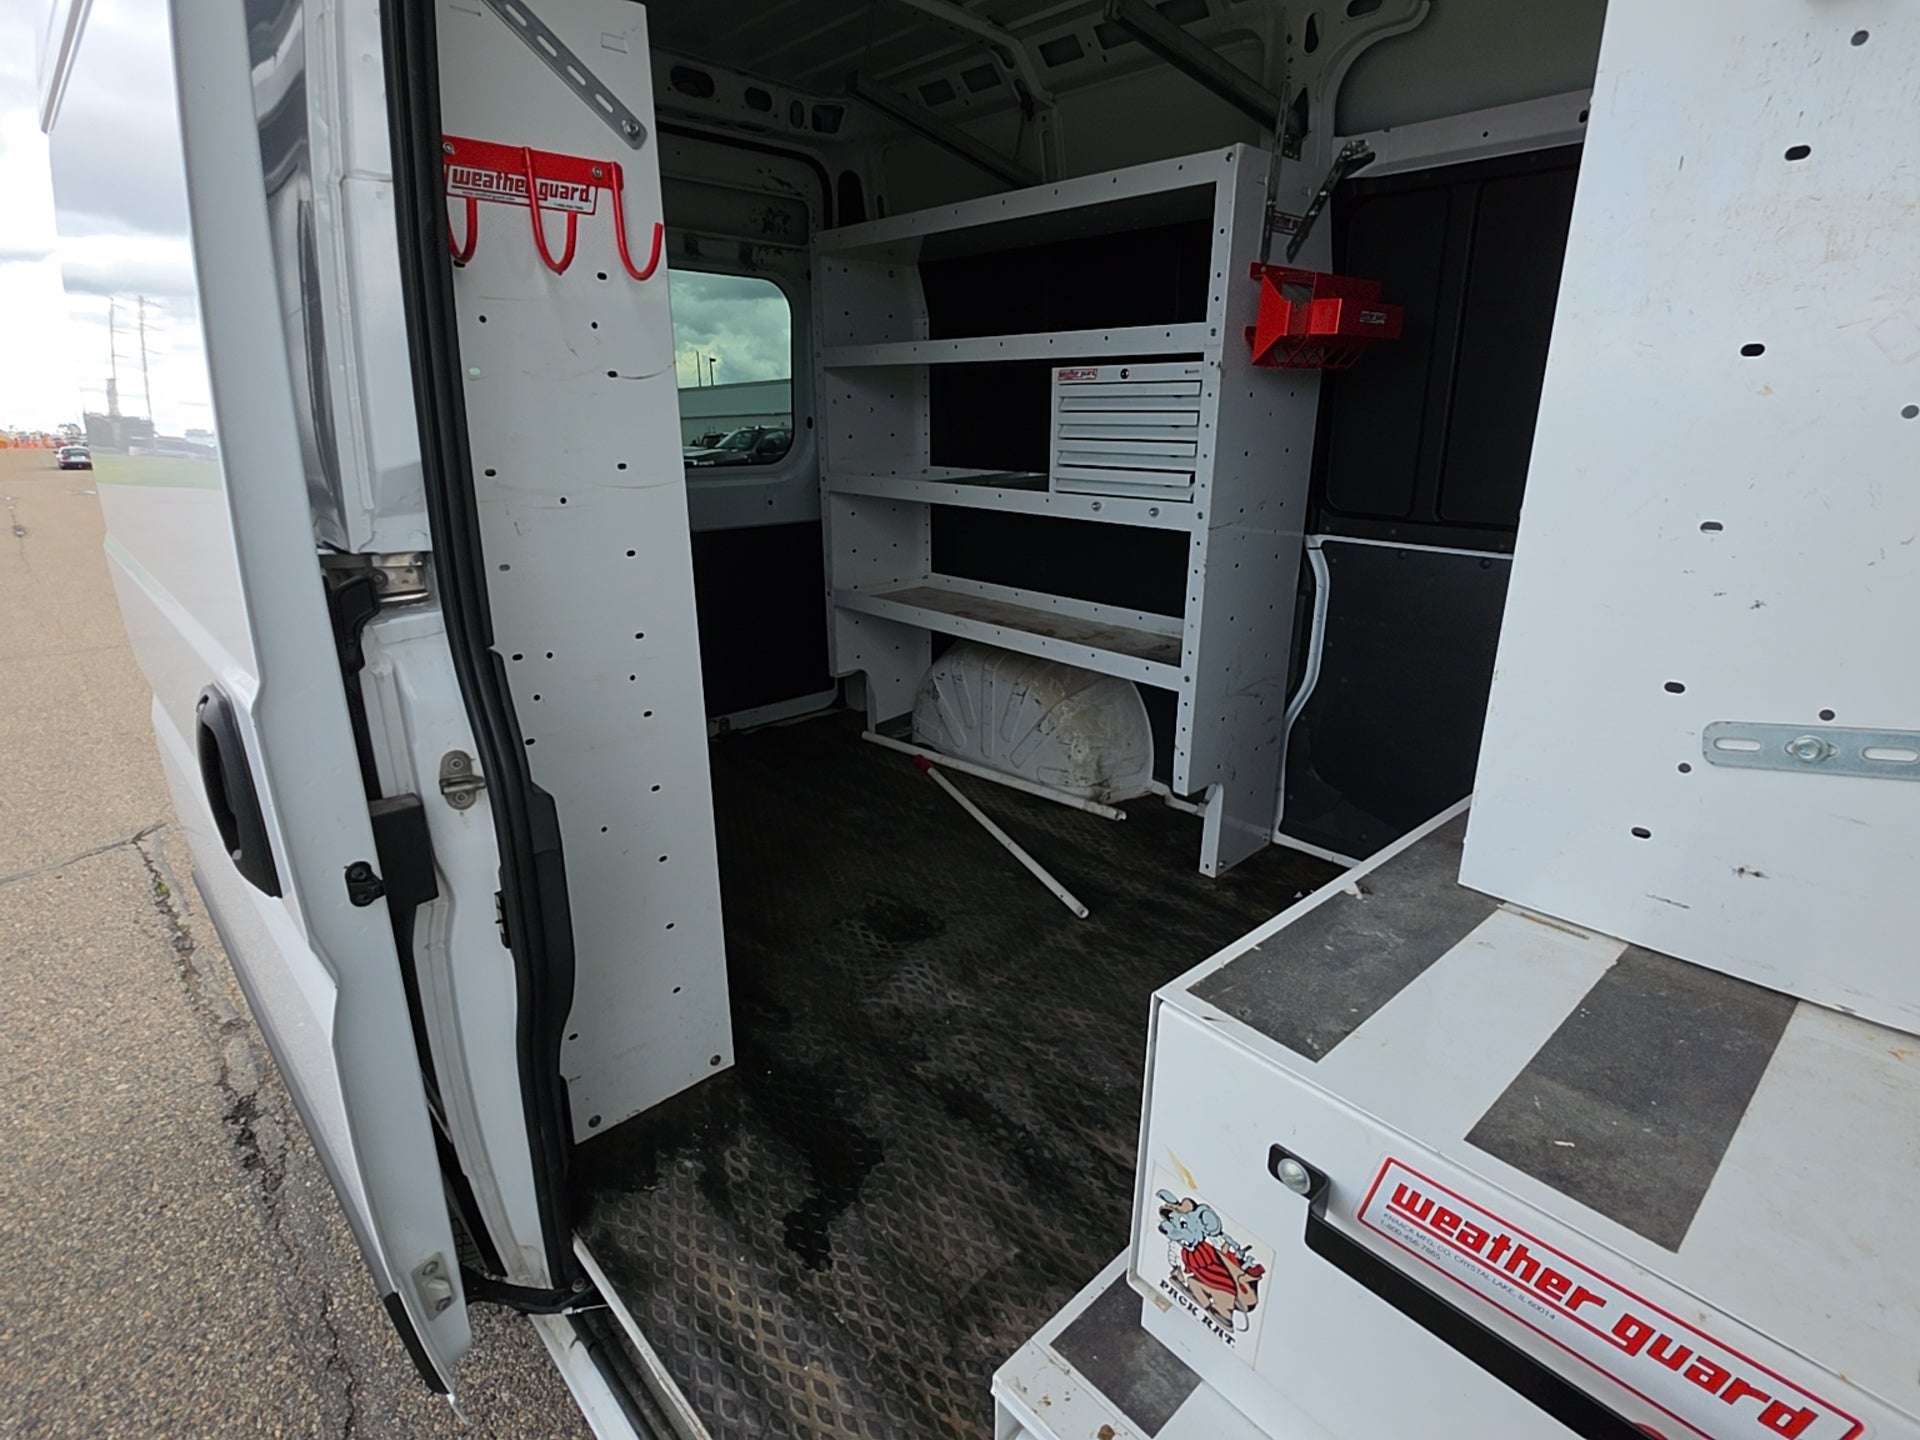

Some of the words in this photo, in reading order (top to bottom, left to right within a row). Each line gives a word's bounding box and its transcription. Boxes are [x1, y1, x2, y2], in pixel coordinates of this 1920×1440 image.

[539, 182, 589, 203] guard
[1159, 1279, 1199, 1317] PACK
[1391, 1183, 1607, 1311] weather
[1611, 1313, 1819, 1440] guard
[1454, 1254, 1492, 1282] CRYSTAL
[1527, 1299, 1556, 1320] 60014
